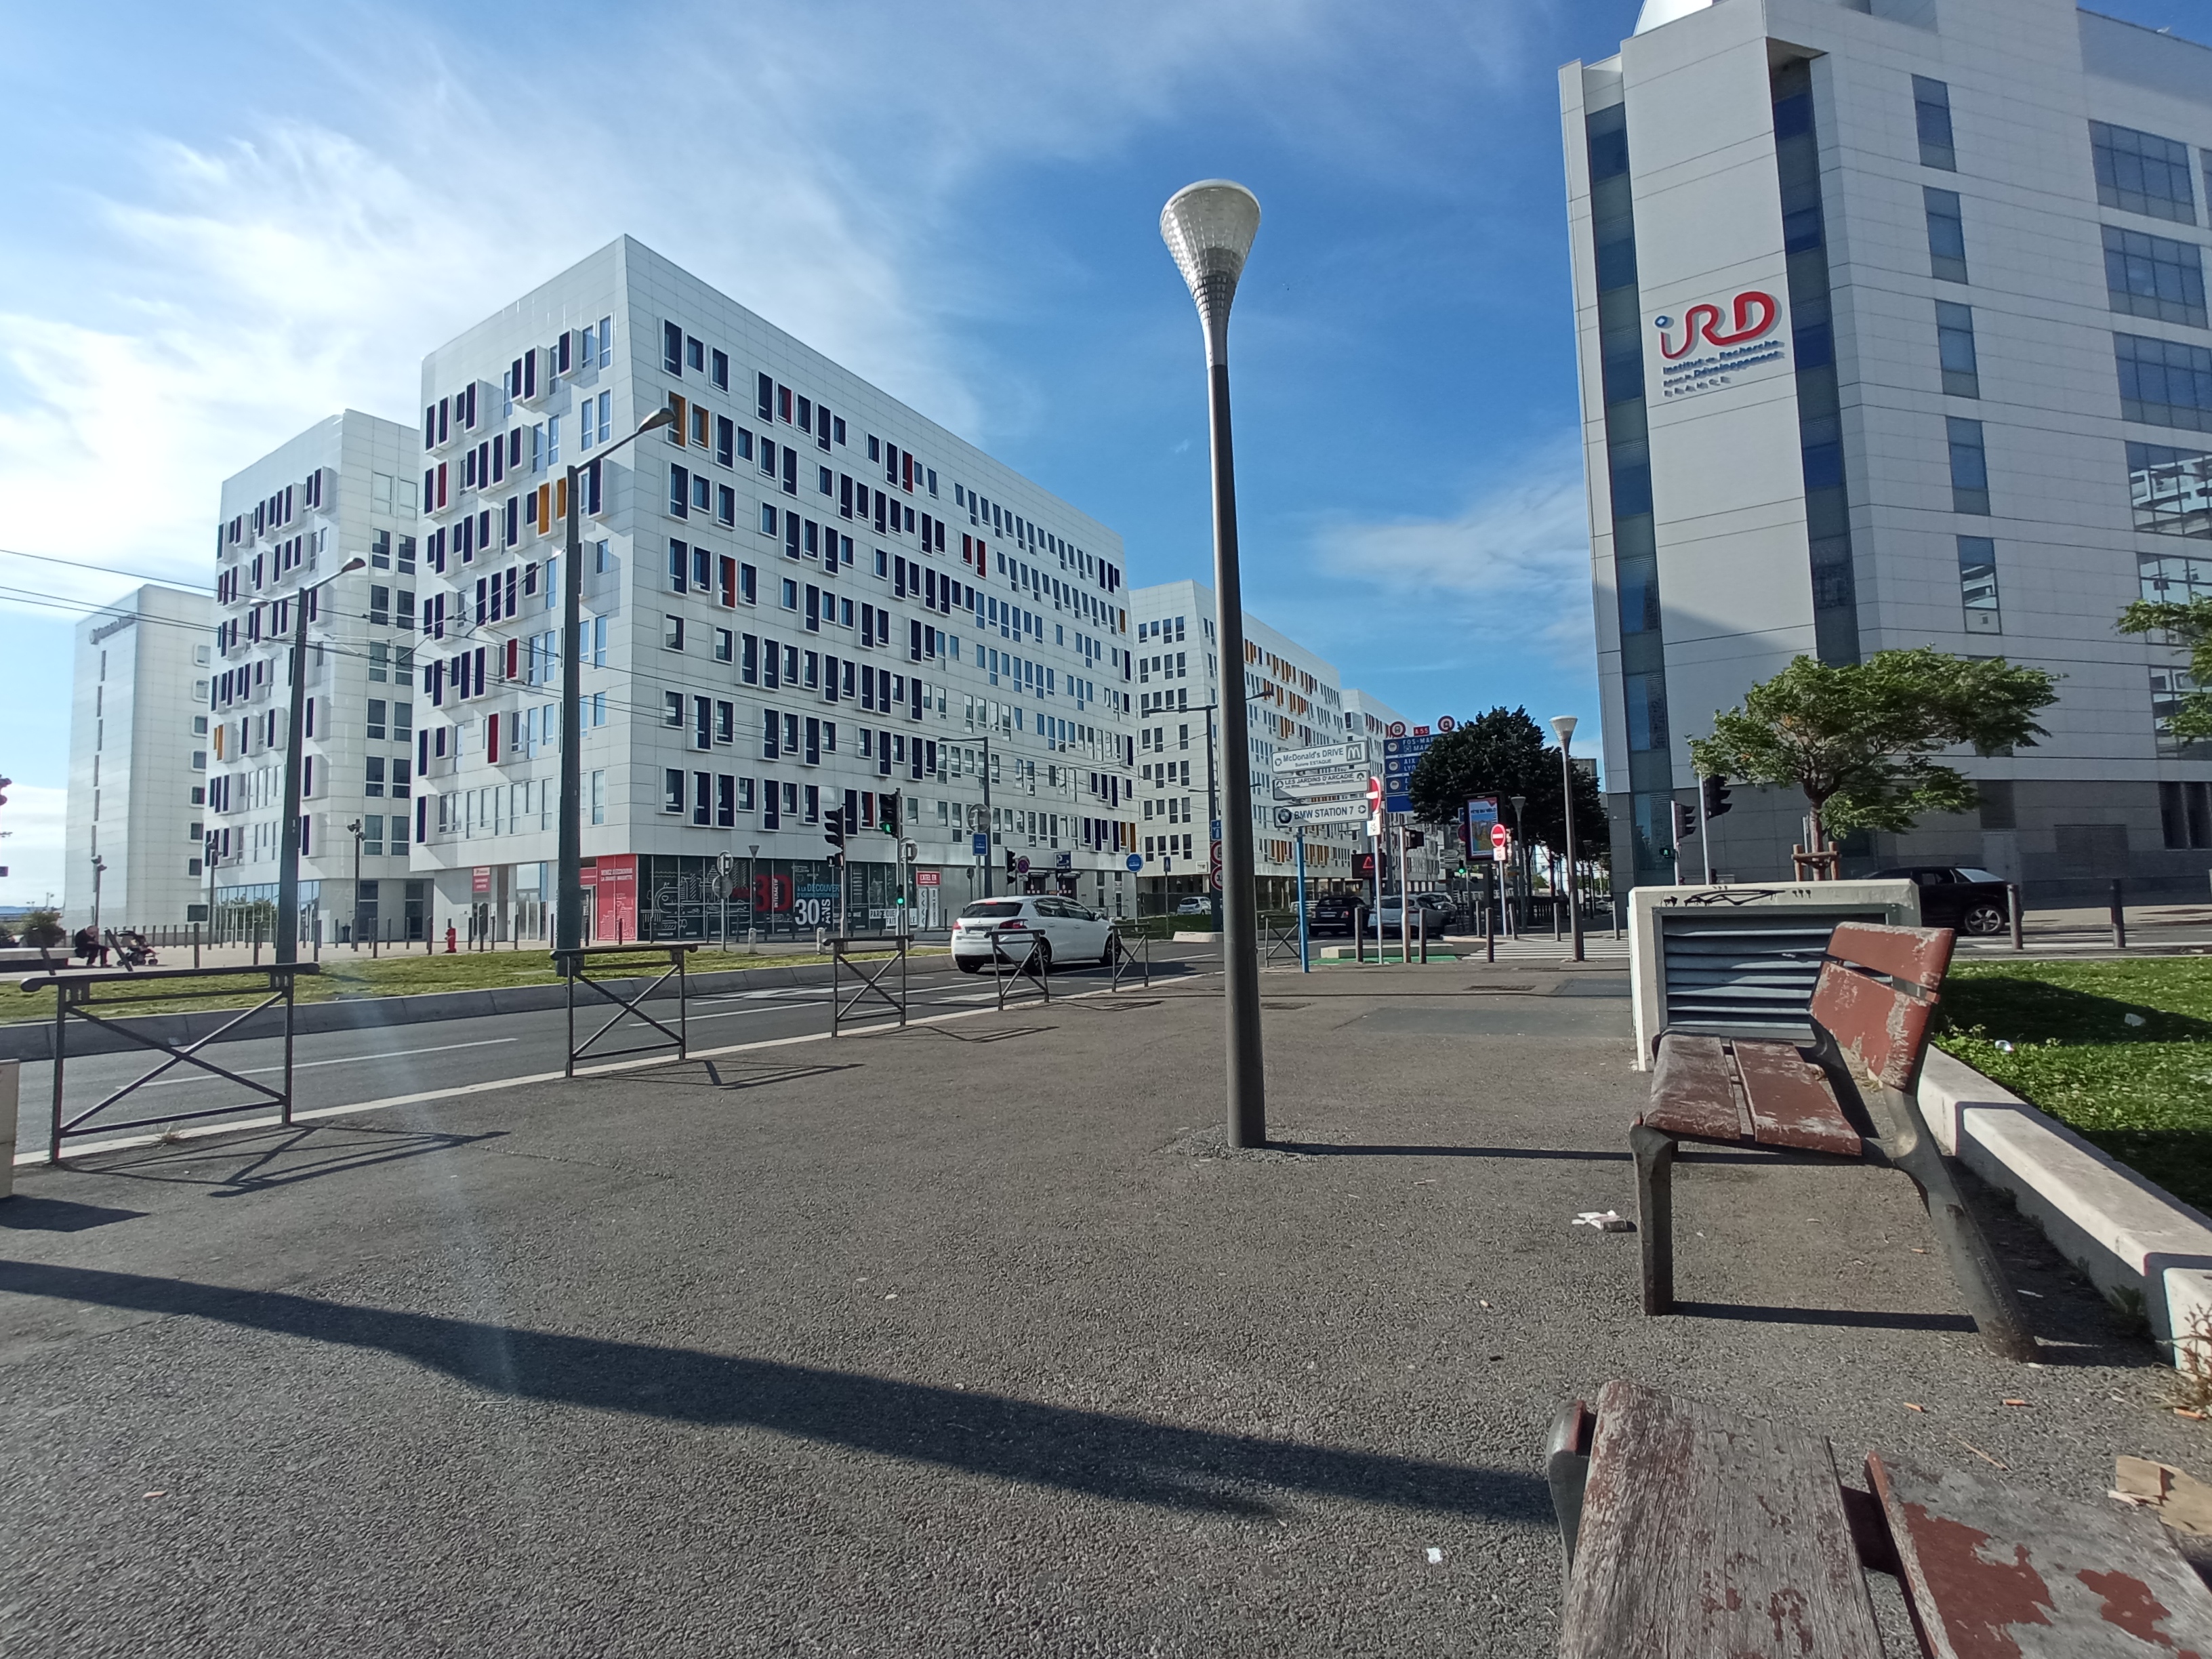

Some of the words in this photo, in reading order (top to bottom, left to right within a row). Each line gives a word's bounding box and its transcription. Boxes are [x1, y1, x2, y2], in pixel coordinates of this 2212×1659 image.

[1662, 358, 1704, 374] Institut
[1719, 340, 1780, 361] Recherche
[1283, 751, 1321, 762] McDonald's
[1322, 747, 1344, 757] DRIVE
[1322, 773, 1354, 781] D'ARCADIE
[1294, 810, 1313, 820] BMW
[1315, 806, 1347, 818] STATION
[1349, 806, 1354, 815] 7
[807, 883, 840, 893] DÉCOUVER
[794, 899, 821, 925] 30
